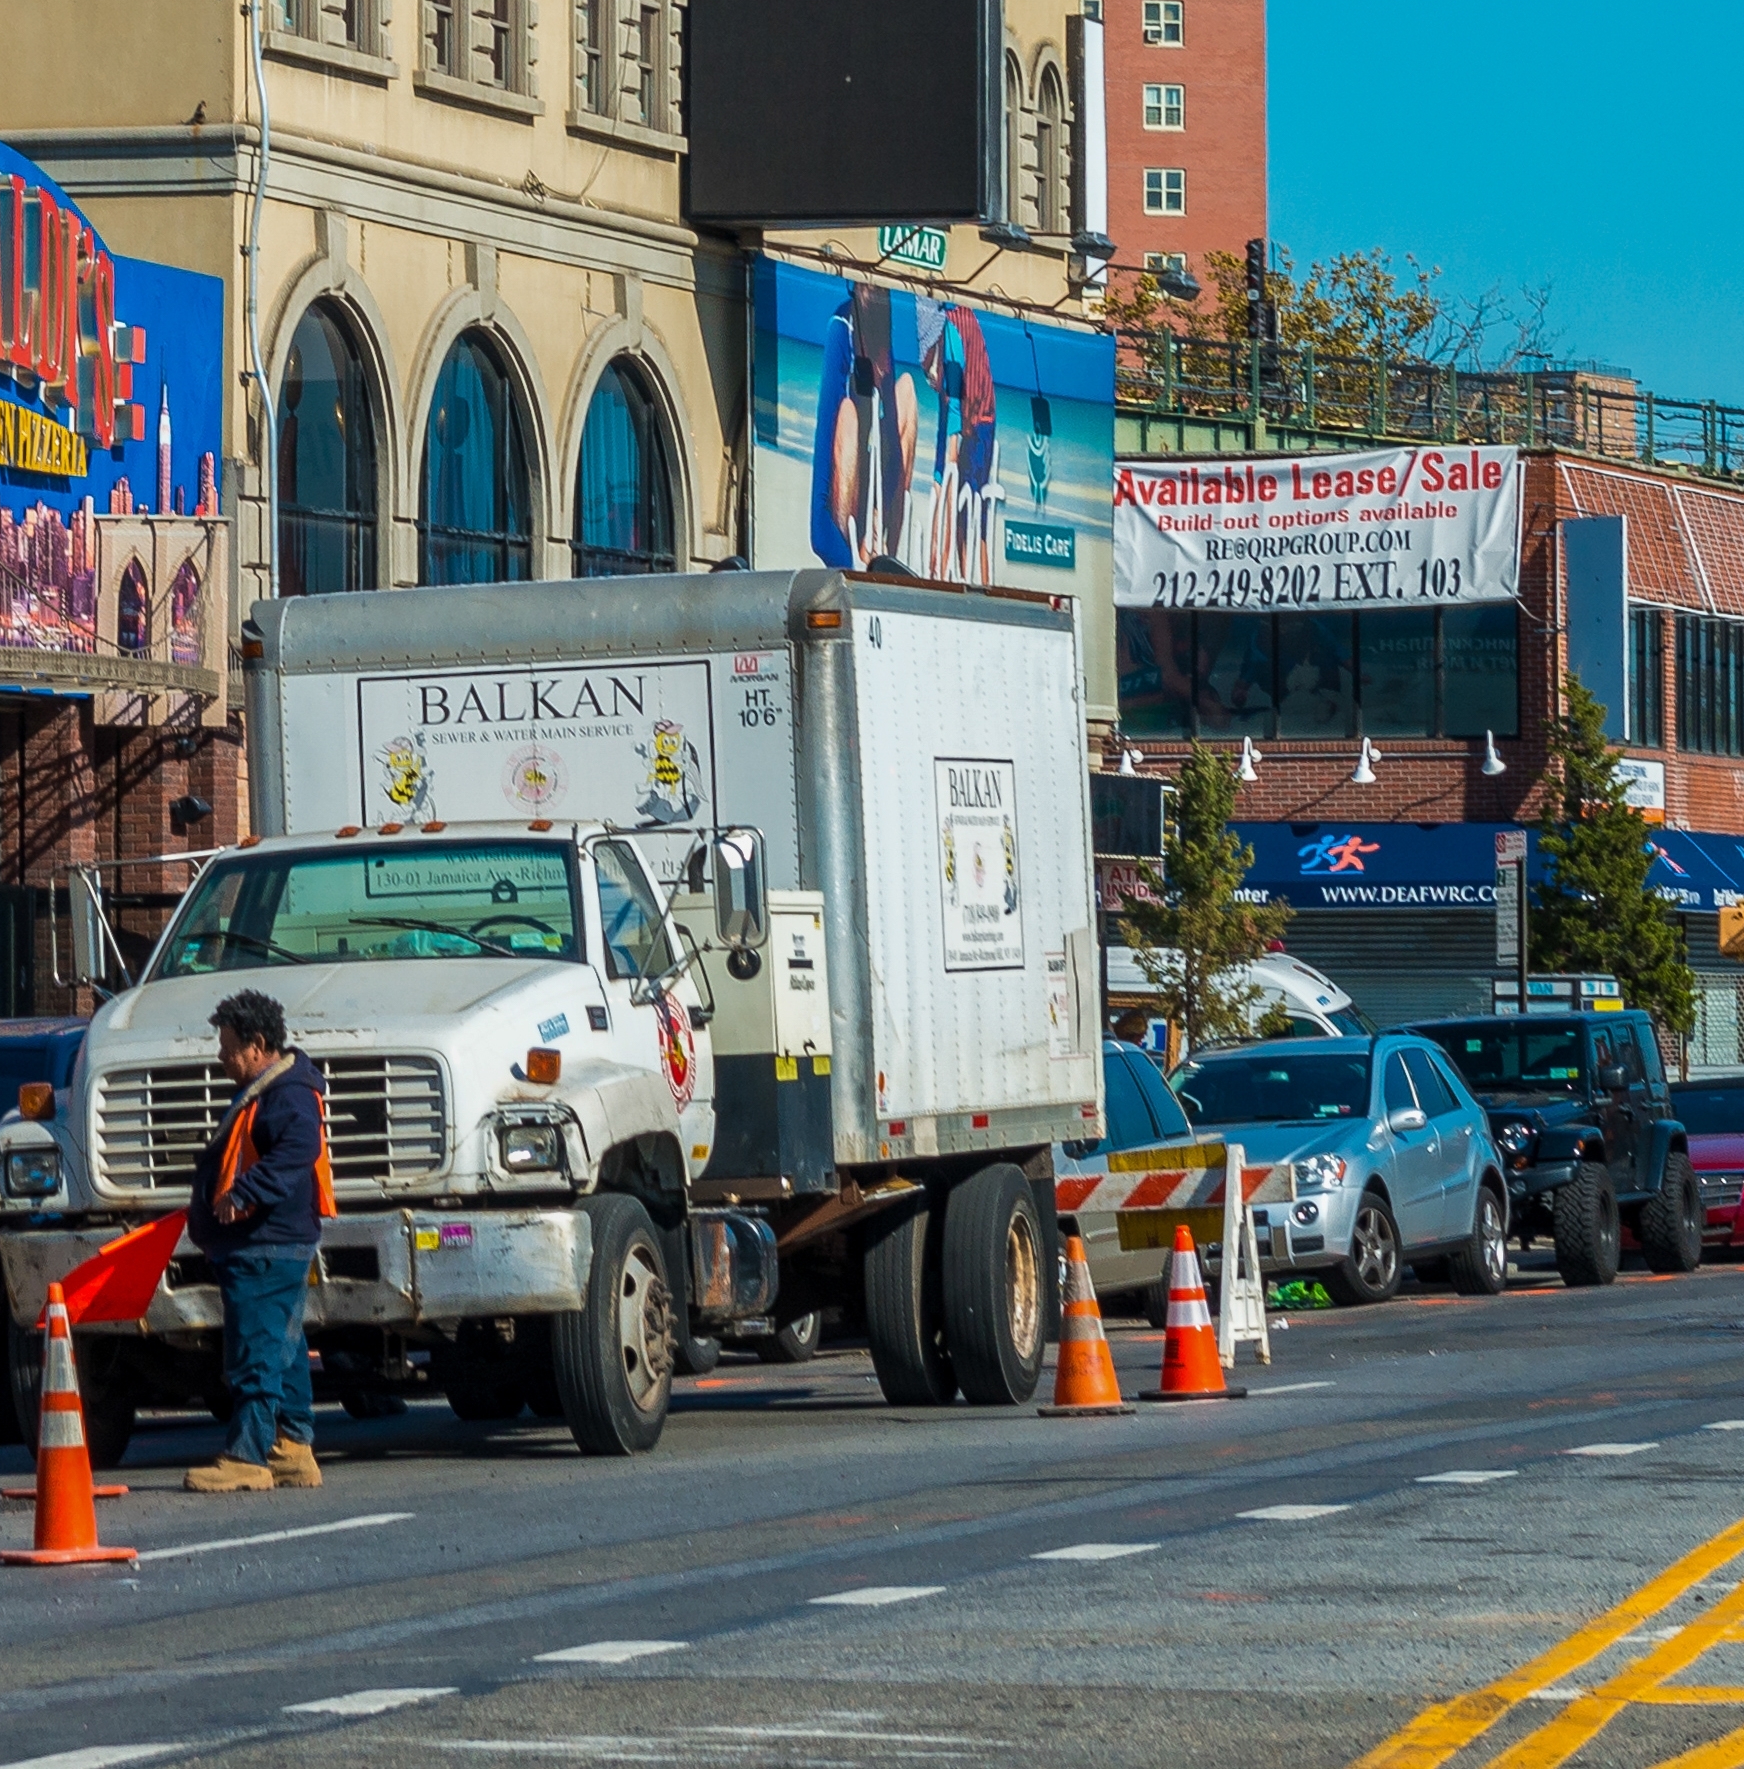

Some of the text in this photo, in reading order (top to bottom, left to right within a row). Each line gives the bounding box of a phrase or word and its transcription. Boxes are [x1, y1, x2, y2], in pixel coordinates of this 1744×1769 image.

[883, 225, 941, 264] LAMAR
[1114, 450, 1503, 507] Available Lease/Sale
[1157, 500, 1458, 533] Build-out options available
[1006, 527, 1043, 554] FIDELIS
[1205, 529, 1412, 565] RE@QRPGROUP.COM
[1152, 557, 1462, 608] 212-249-8202 EXT. 103
[418, 675, 648, 727] BALKAN
[744, 689, 774, 707] HT.
[737, 706, 784, 728] 10'6"
[432, 723, 634, 747] SEWER & WATER MAIN SERVICE
[948, 768, 1003, 809] BALKAN
[374, 871, 421, 888] 130-01
[425, 867, 484, 887] Jamaica
